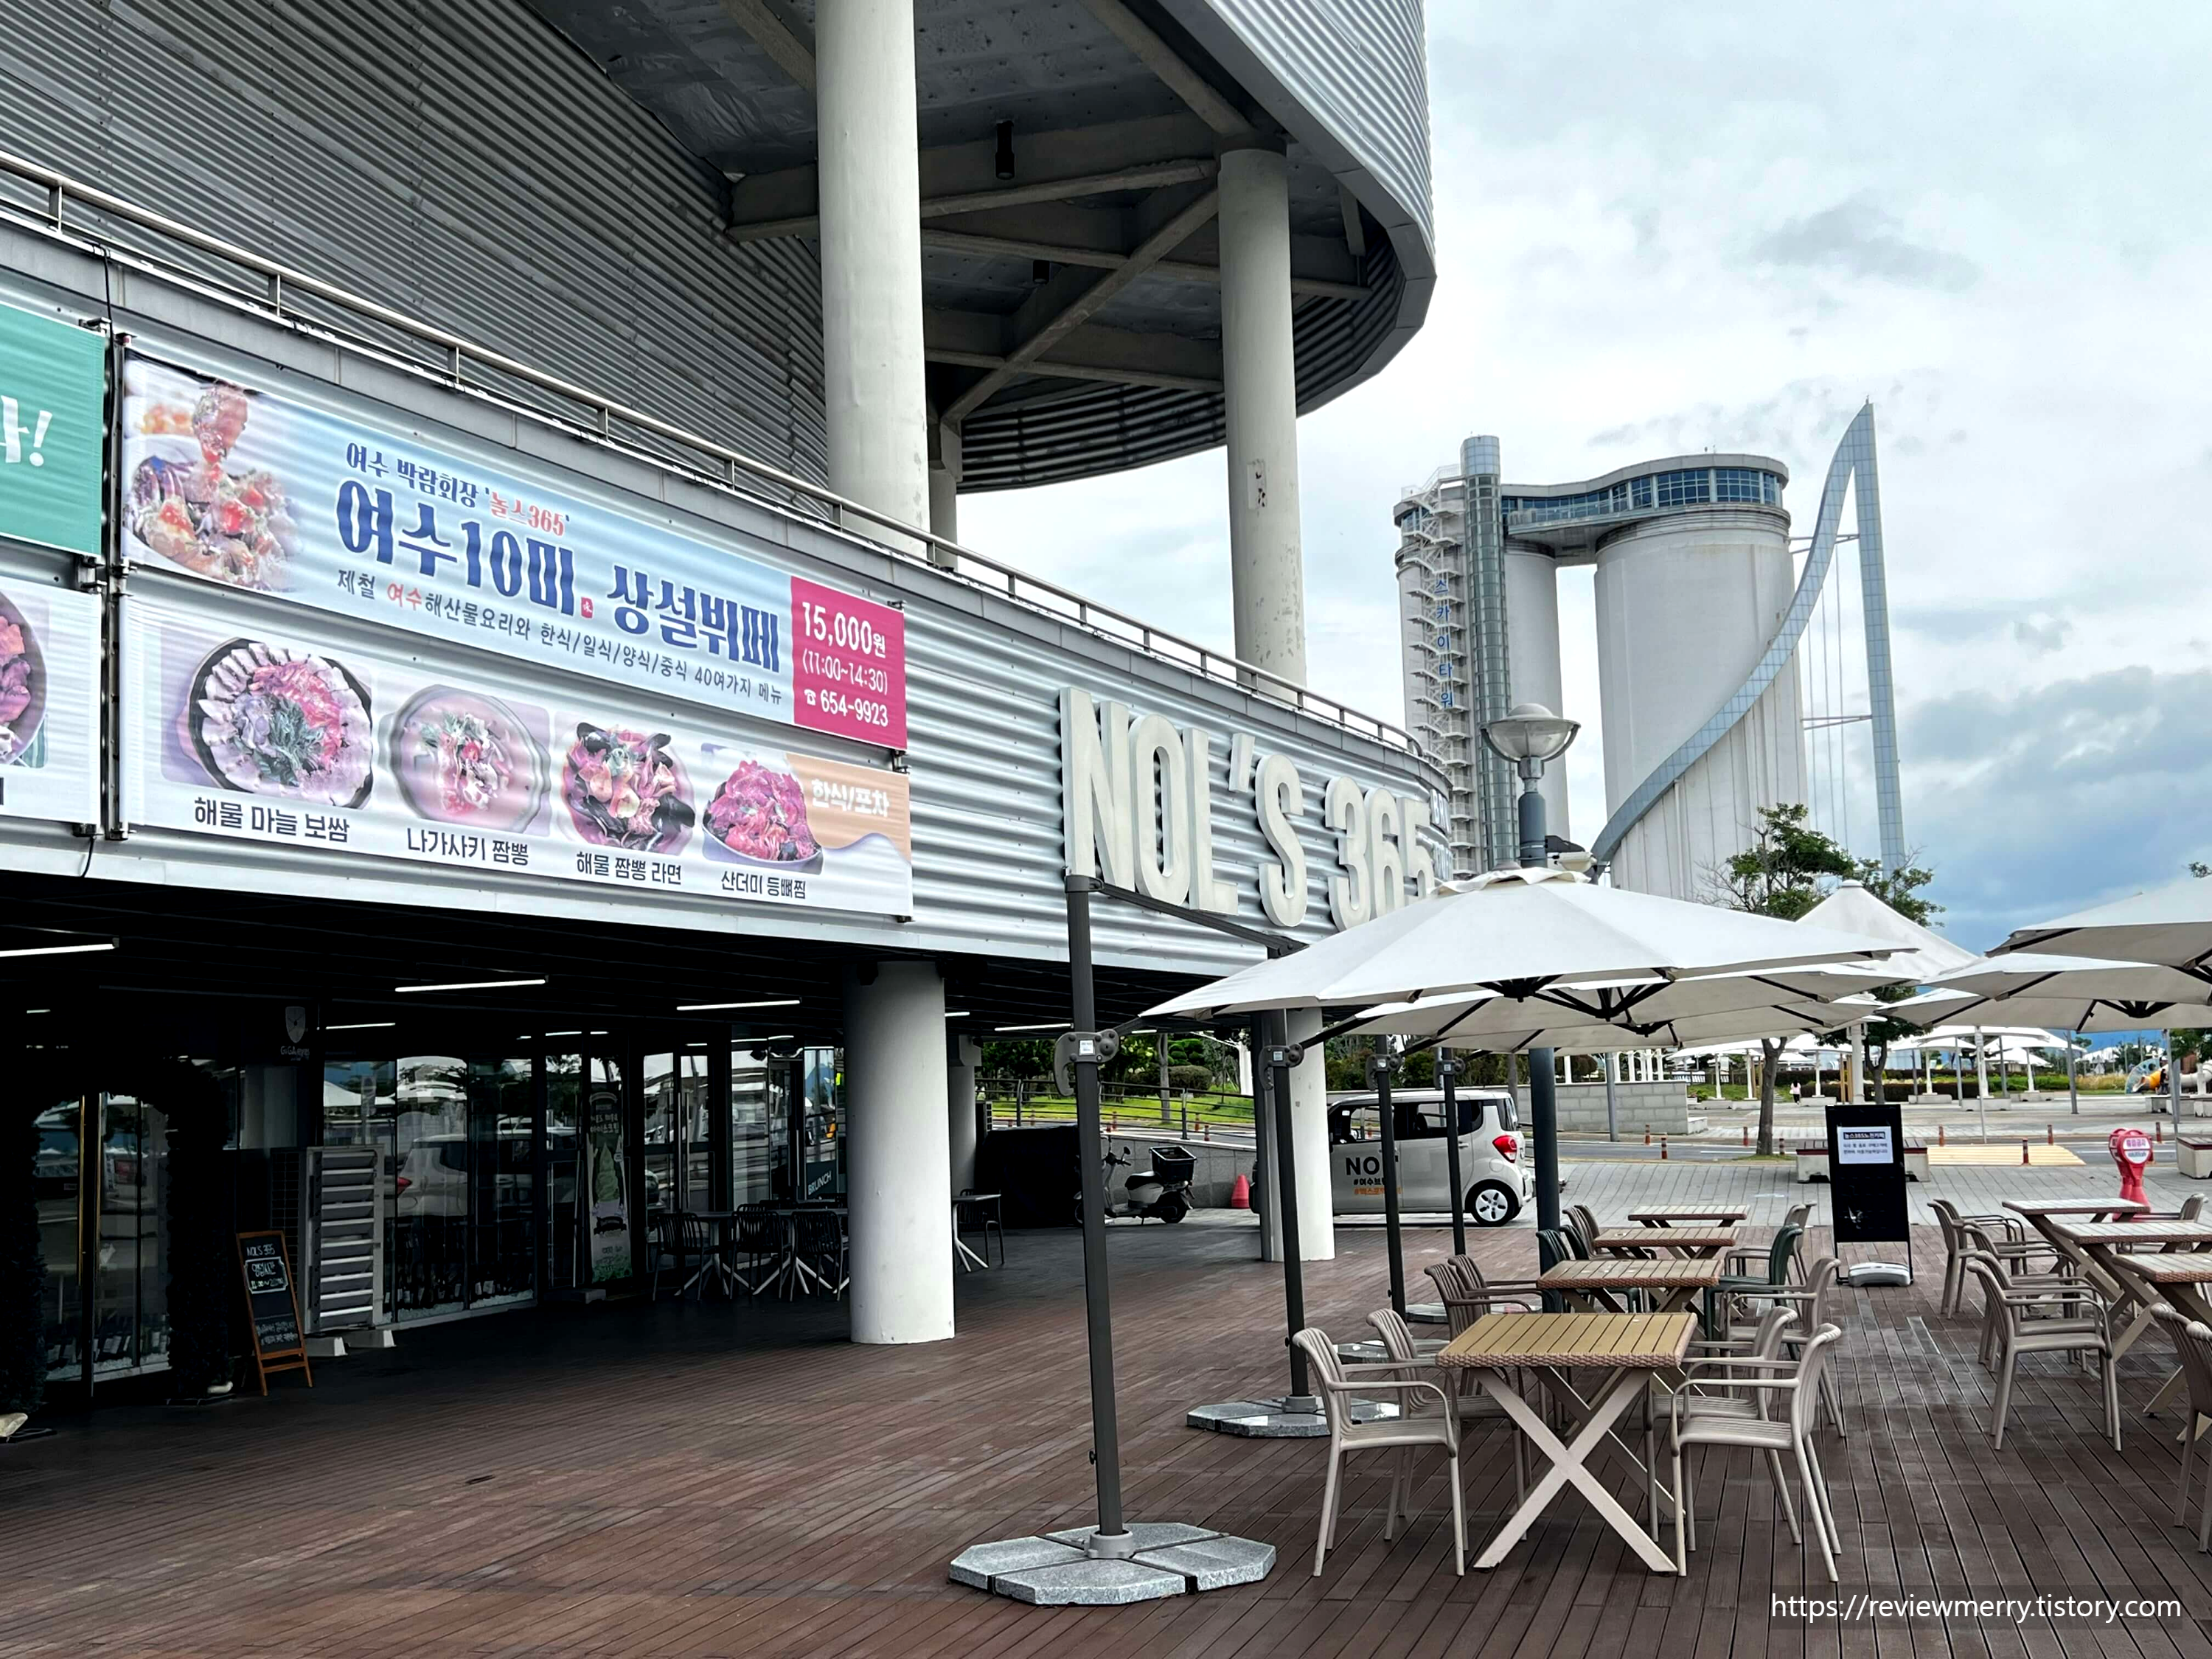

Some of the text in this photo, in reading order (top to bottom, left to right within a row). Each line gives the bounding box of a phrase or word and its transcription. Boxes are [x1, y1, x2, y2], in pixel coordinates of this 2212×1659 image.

[347, 442, 390, 478] 여수
[397, 459, 479, 508] 박람회장
[338, 569, 375, 599] 제철
[540, 623, 687, 681] 한식/일식/양식/중식
[695, 667, 751, 698] 40여가지
[759, 683, 782, 705] 메뉴
[607, 565, 779, 673] 상설뷔페
[802, 602, 886, 658] 15,000원
[1434, 579, 1454, 708] 스카이타워
[802, 648, 888, 695] (11:00~14:30)
[821, 689, 888, 727] 654-9923
[194, 796, 349, 844] 해물 마늘 보쌈
[811, 779, 889, 818] 한식/포차
[1060, 686, 1435, 931] NOL'S 365
[406, 827, 529, 866] 나가사키 짬뽕
[576, 851, 681, 886] 해물 짬뽕 라면
[721, 871, 806, 900] 산더미 등뼈찜
[808, 1170, 832, 1195] BRUNCH
